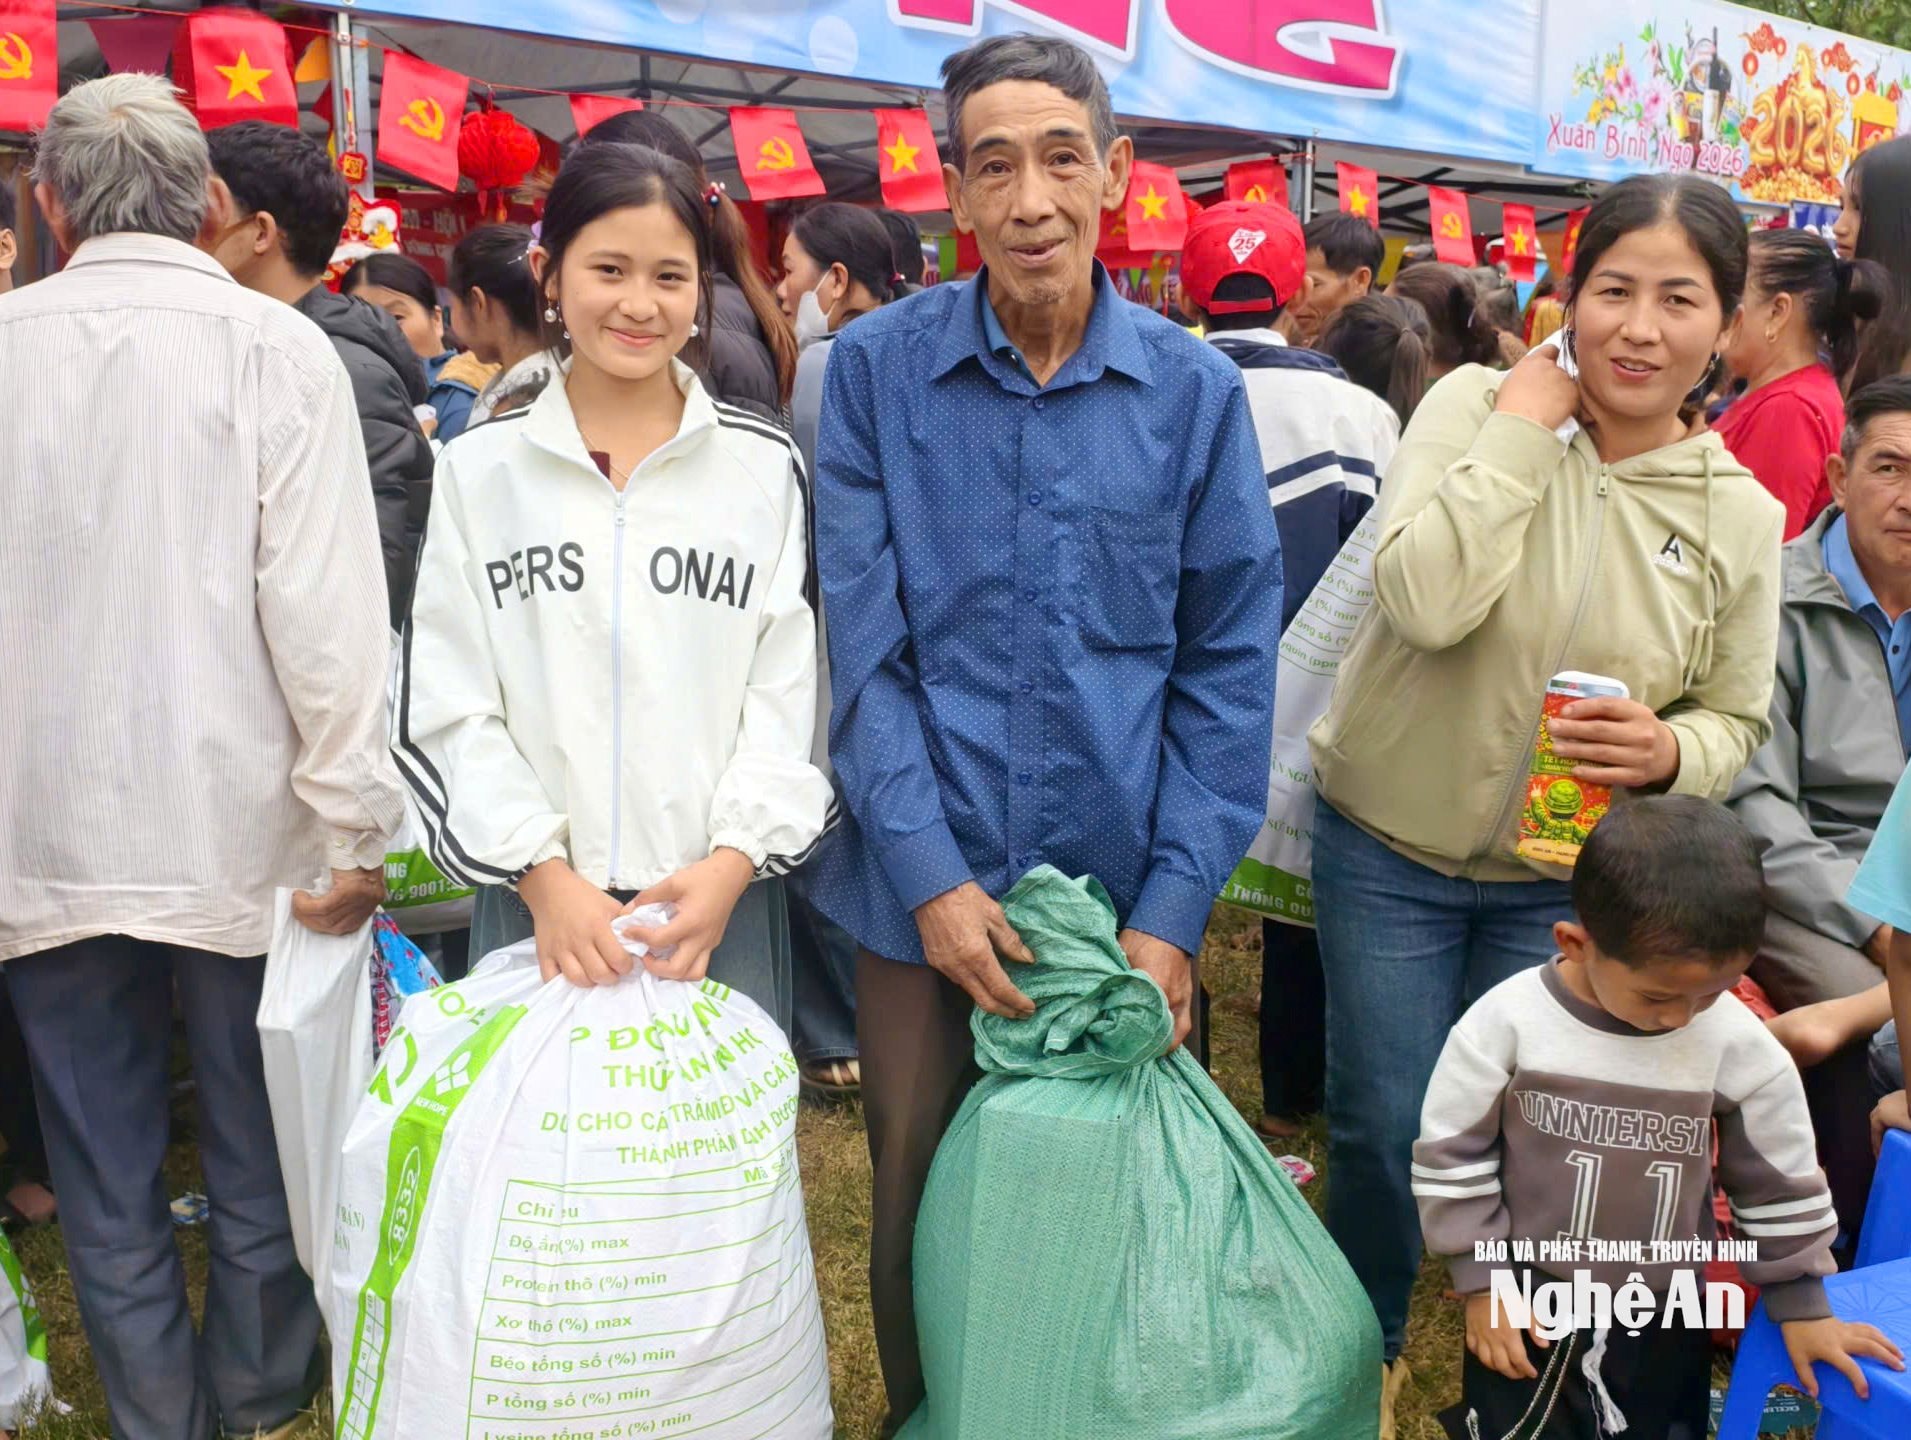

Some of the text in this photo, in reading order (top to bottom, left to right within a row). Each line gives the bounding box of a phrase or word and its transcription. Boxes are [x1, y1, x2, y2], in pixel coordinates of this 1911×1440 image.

[1750, 86, 1847, 178] 2026
[1546, 112, 1596, 149] Xuân
[1698, 143, 1743, 175] 2026
[1233, 237, 1257, 250] 25
[485, 541, 585, 610] PERS
[577, 1111, 632, 1132] CHO
[391, 1170, 418, 1241] 8332
[591, 1237, 630, 1250] max
[599, 1275, 629, 1292] (%)
[634, 1271, 668, 1286] min
[558, 1316, 589, 1333] (%)
[595, 1315, 633, 1330] max
[490, 1354, 526, 1372] Béo
[579, 1352, 602, 1369] số
[607, 1352, 637, 1369] (%)
[642, 1347, 677, 1362] min
[486, 1393, 500, 1406] P
[553, 1392, 577, 1408] số
[582, 1392, 612, 1408] (%)
[617, 1387, 651, 1402] min
[628, 1420, 656, 1436] (%)
[661, 1412, 692, 1428] min
